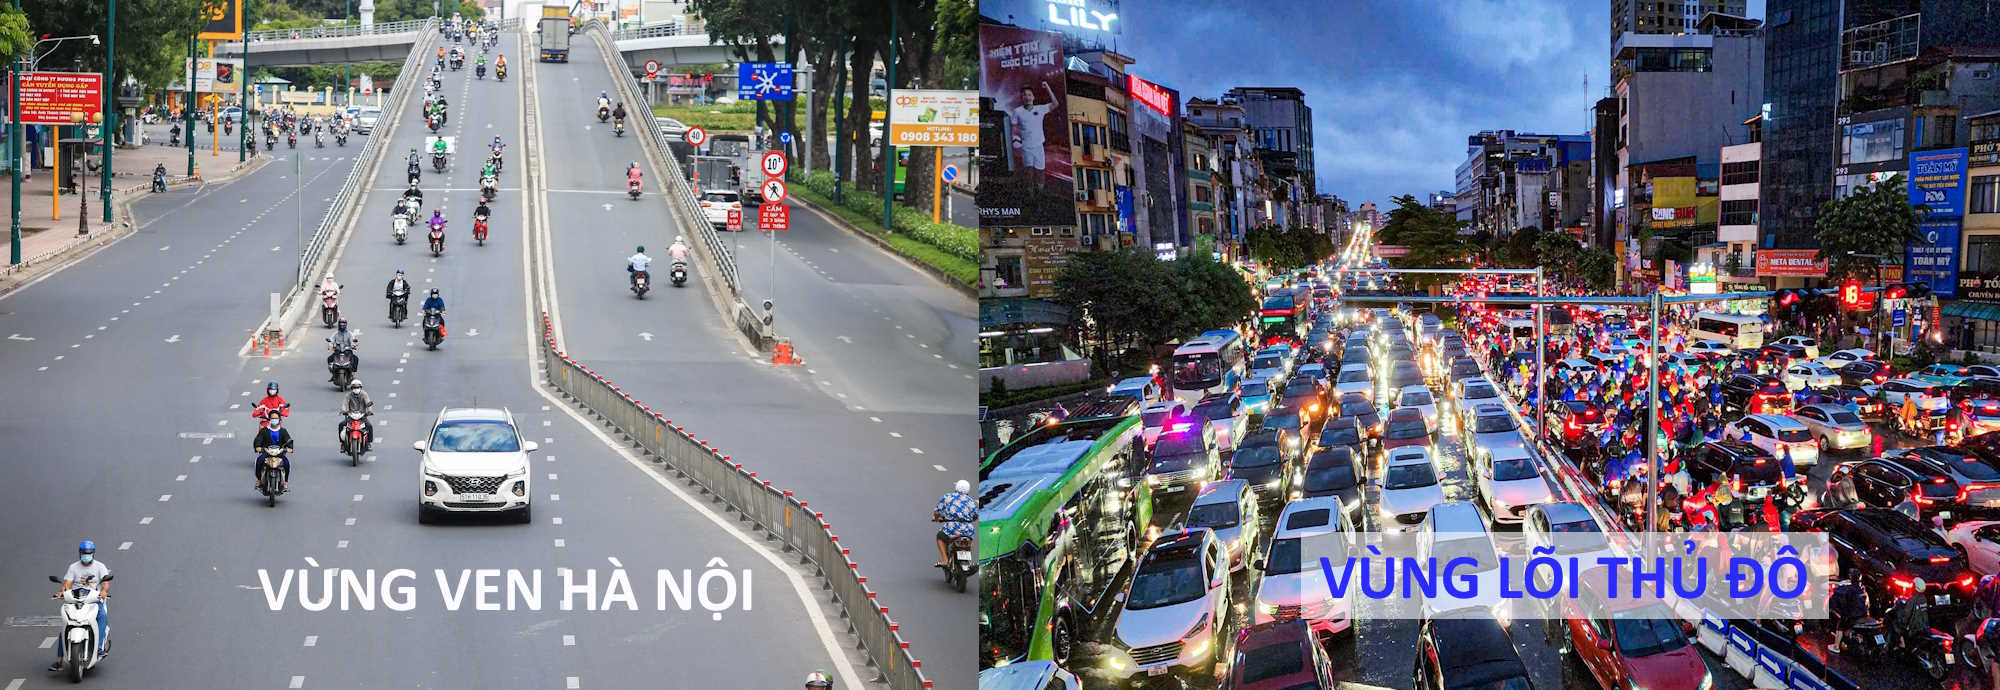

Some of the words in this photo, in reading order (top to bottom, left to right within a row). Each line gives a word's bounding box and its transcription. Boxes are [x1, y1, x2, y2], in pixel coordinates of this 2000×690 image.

[1048, 3, 1118, 31] LILY
[1838, 117, 1851, 125] 393
[691, 132, 700, 140] 40
[901, 132, 930, 141] 0908
[932, 132, 954, 142] 343
[957, 133, 977, 142] 180
[1001, 207, 1021, 216] MAN
[1788, 258, 1813, 266] DENTAL
